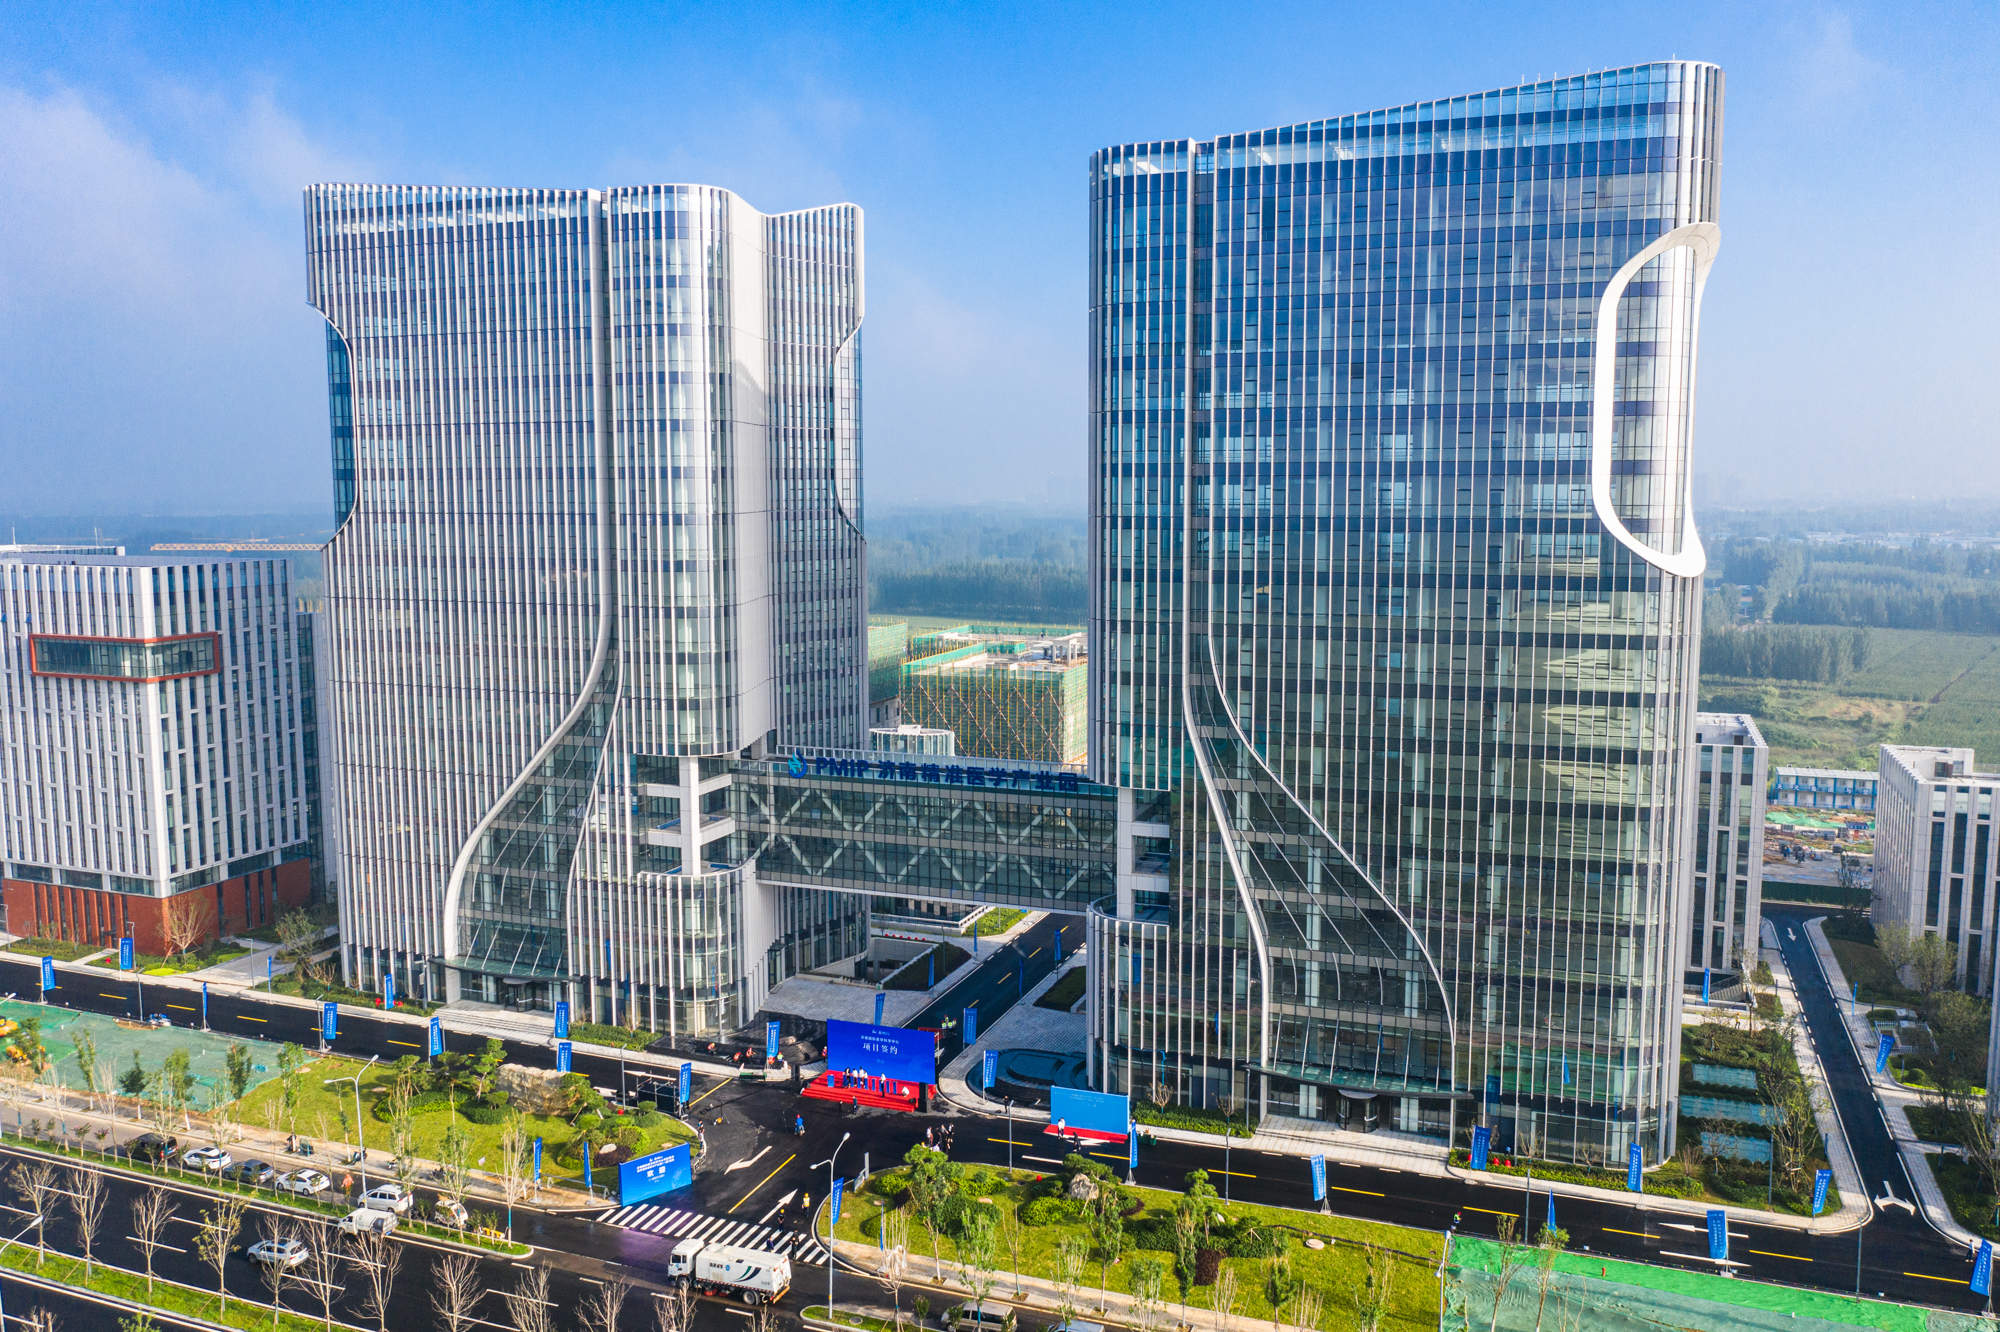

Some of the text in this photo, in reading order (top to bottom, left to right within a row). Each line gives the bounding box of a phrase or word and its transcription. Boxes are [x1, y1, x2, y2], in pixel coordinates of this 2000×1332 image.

[815, 757, 1076, 790] PMIP 济南精准医学产业园
[862, 1043, 897, 1054] 项目签约
